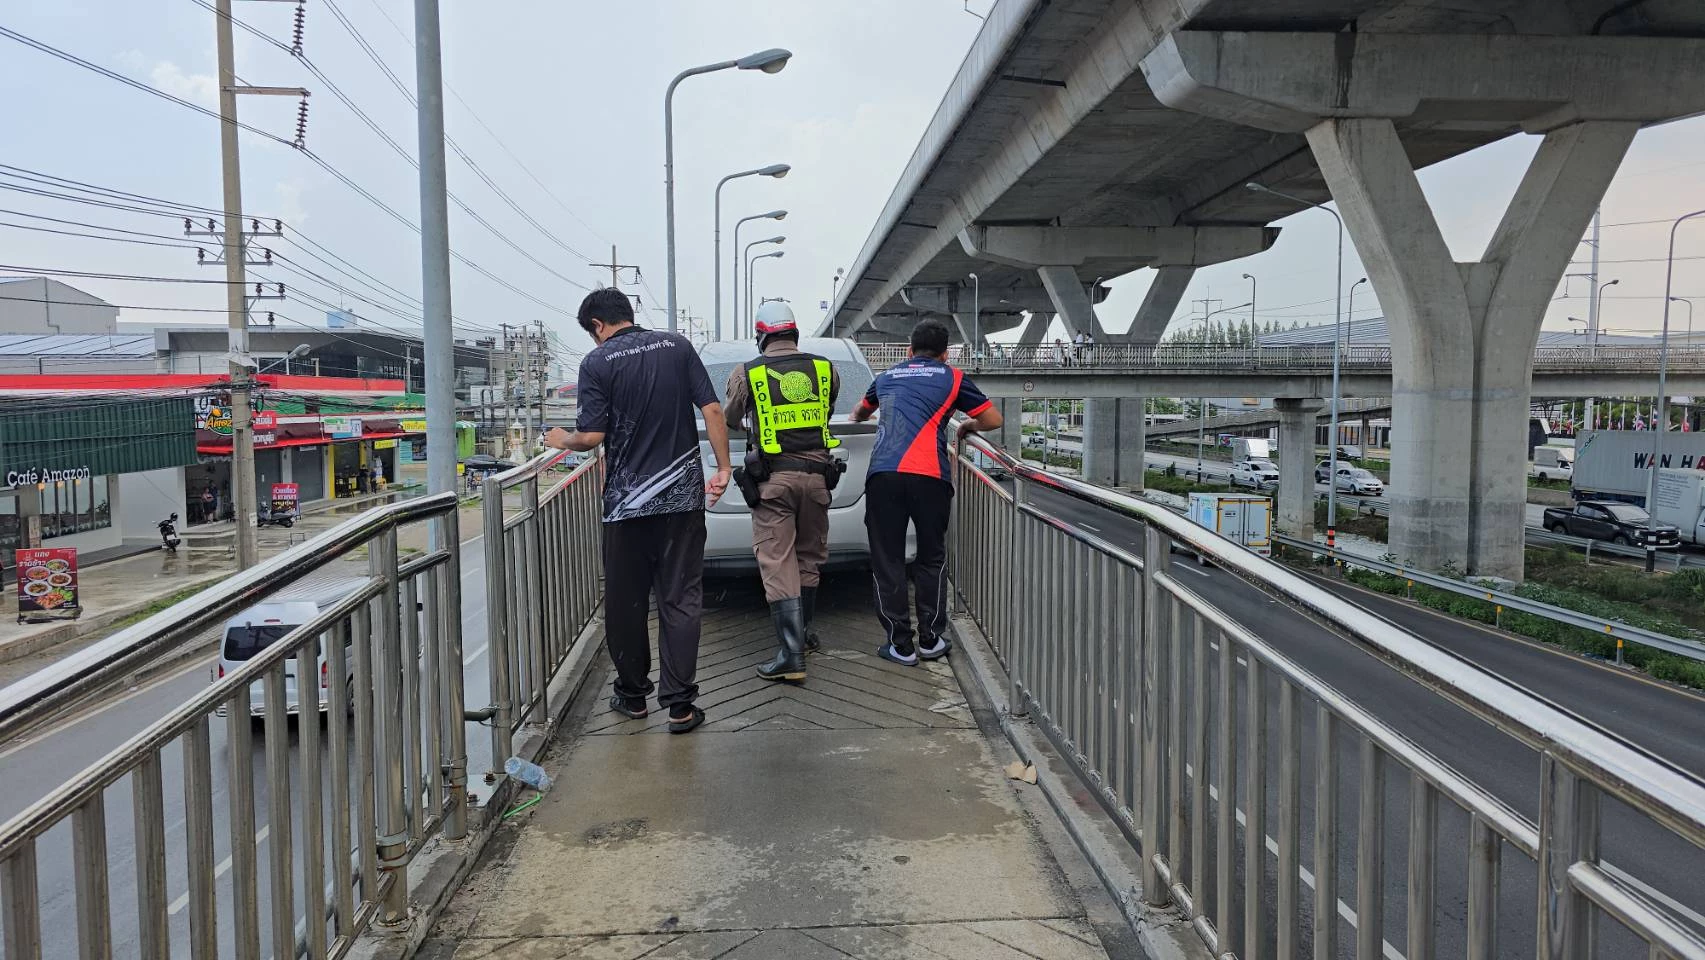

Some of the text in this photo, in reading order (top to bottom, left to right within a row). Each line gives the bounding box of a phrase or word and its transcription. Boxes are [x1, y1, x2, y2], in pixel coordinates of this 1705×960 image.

[773, 407, 821, 425] ตำรวจ จราจร
[1633, 452, 1672, 469] WAN
[7, 467, 39, 487] Café
